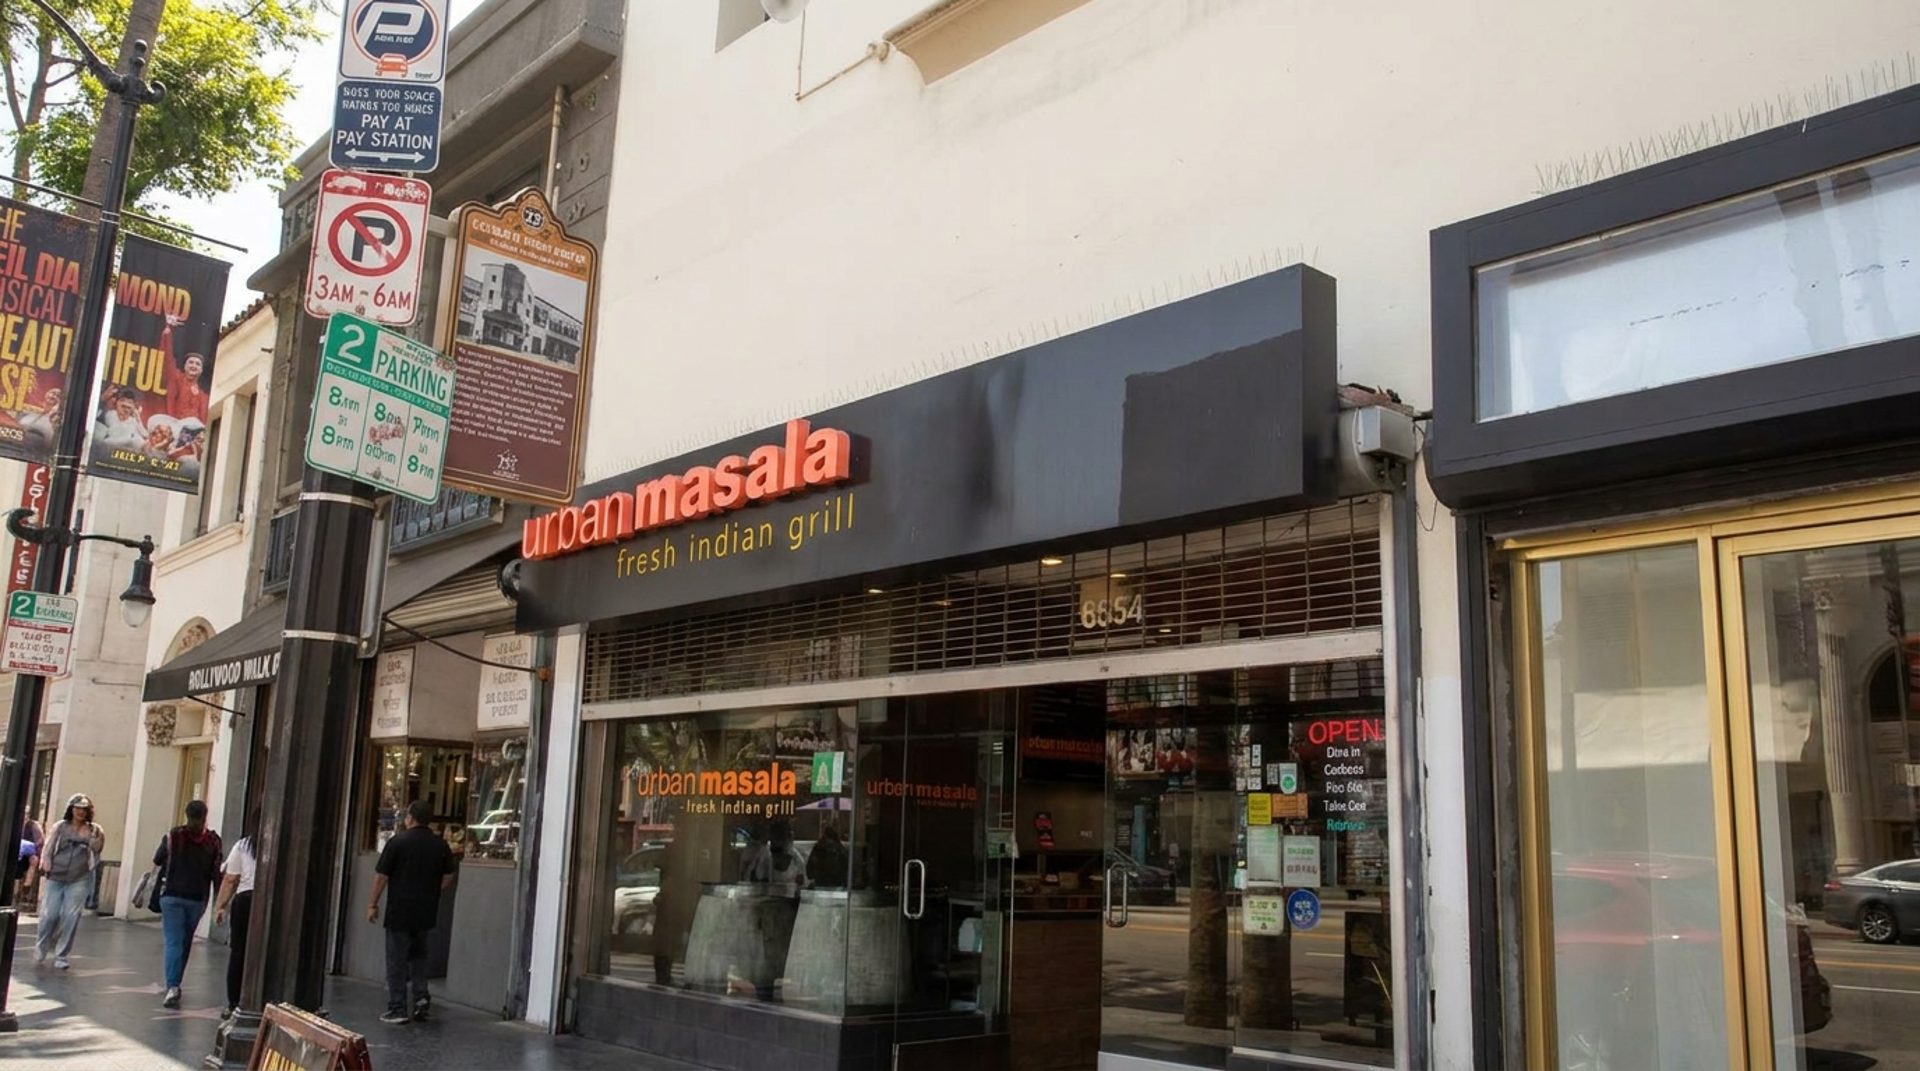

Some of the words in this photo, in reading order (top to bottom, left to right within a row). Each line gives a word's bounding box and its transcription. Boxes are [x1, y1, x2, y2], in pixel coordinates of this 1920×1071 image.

[336, 130, 366, 146] PAY
[371, 132, 433, 150] STATION
[361, 114, 390, 129] PAY
[394, 116, 414, 131] AT
[34, 251, 80, 294] DIA
[116, 272, 192, 322] MOND
[315, 274, 354, 303] 3AM
[373, 283, 411, 311] 6AM
[337, 324, 366, 364] 2
[375, 349, 448, 401] PARKING
[634, 418, 850, 531] masala
[617, 539, 676, 578] fresh
[689, 520, 774, 563] indian
[788, 493, 856, 550] grill
[15, 595, 31, 615] 2
[1309, 719, 1379, 744] OPEN
[699, 762, 797, 796] masala
